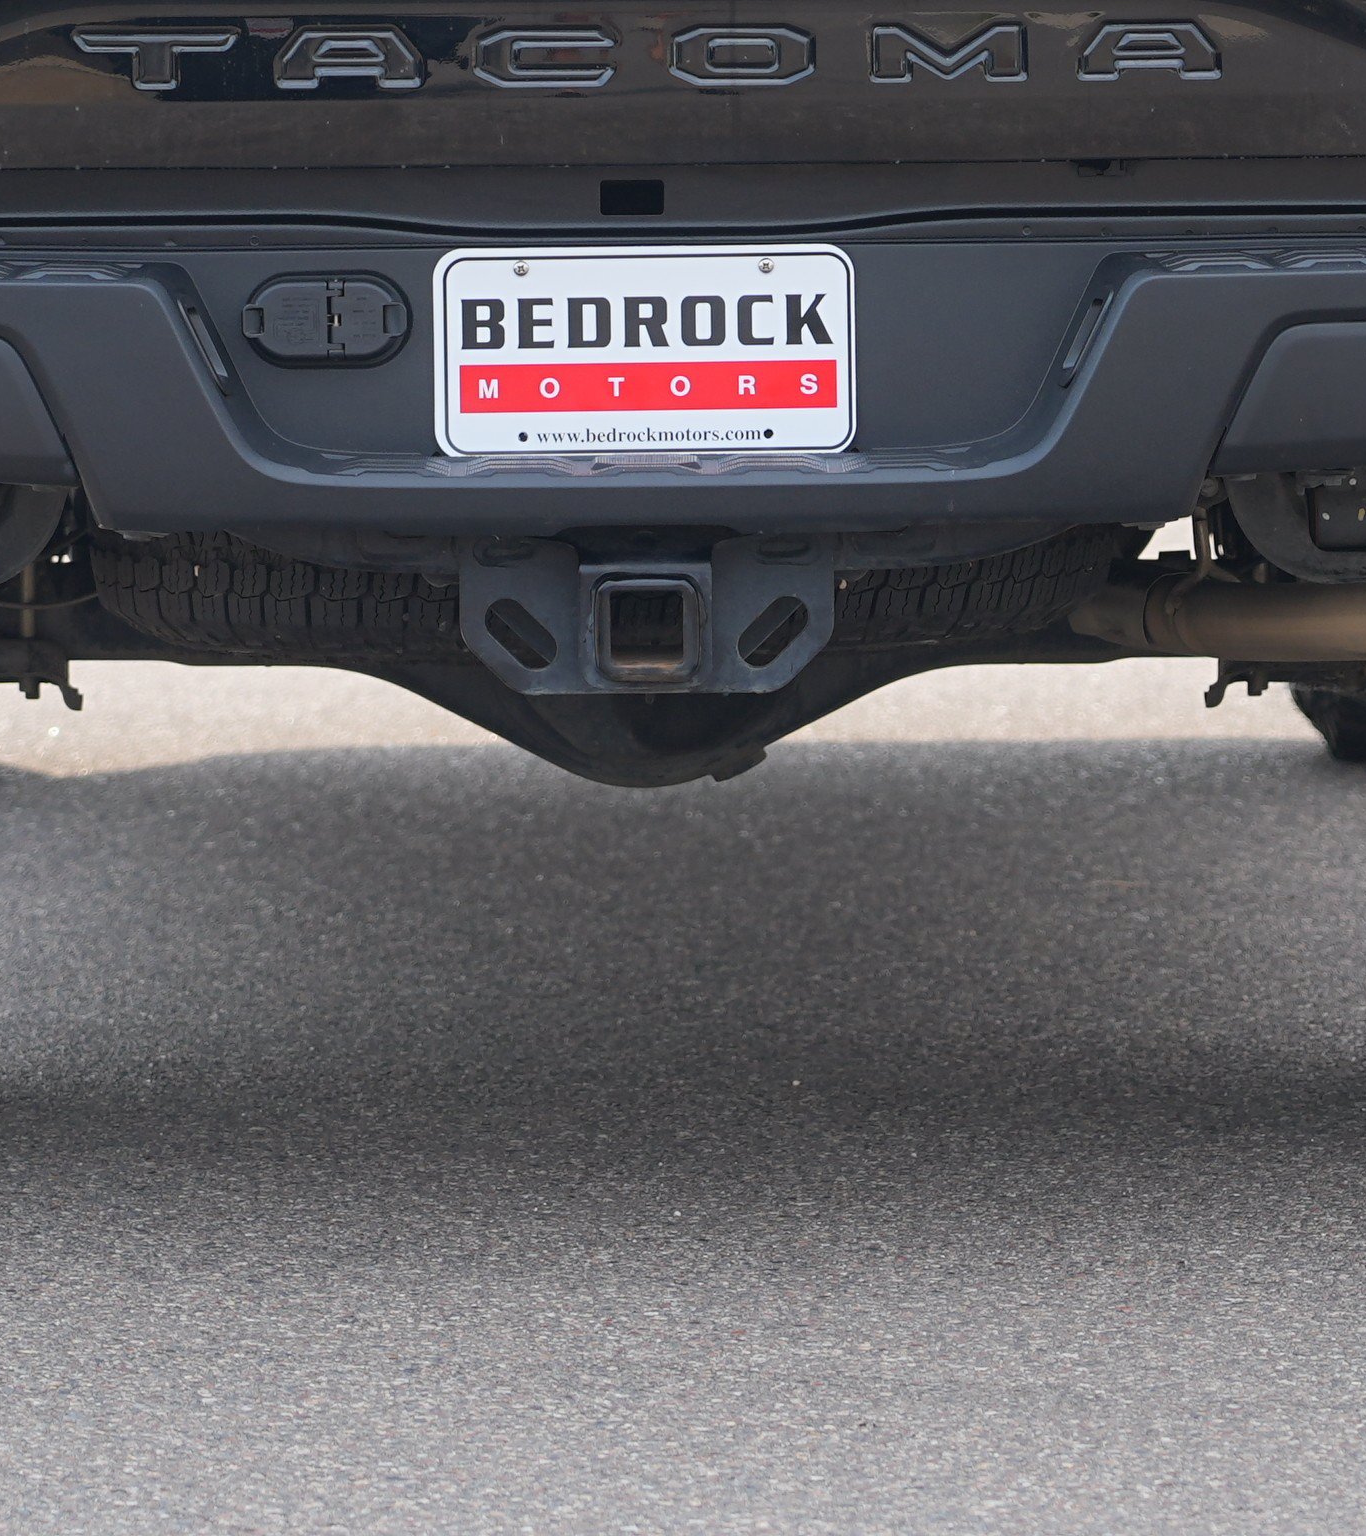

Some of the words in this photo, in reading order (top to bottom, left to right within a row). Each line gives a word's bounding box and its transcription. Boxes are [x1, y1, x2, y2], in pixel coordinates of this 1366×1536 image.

[69, 21, 1224, 92] TACOMA
[460, 293, 834, 350] BEDROCK
[478, 373, 819, 400] MOTORS
[536, 427, 762, 444] www.bedrockmotors.com
